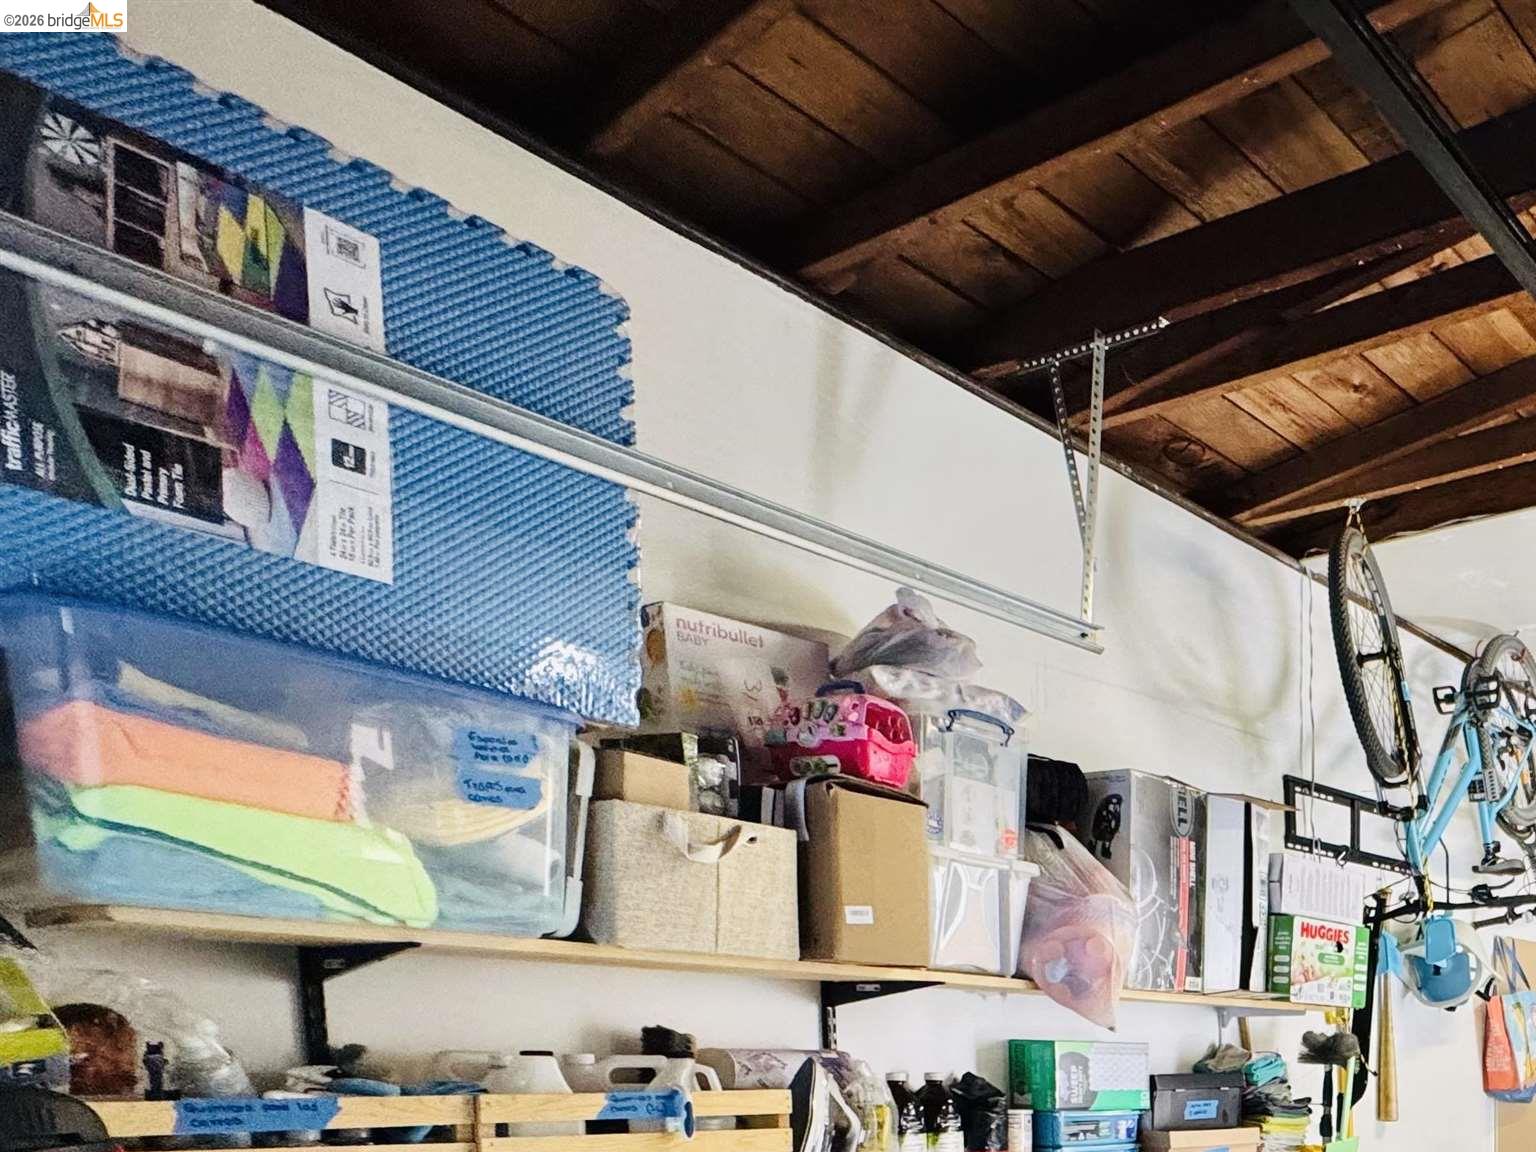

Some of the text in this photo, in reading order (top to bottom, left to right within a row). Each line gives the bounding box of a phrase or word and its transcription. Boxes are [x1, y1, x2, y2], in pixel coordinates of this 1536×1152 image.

[675, 617, 764, 649] nutribullet
[676, 631, 708, 646] BABY
[1300, 921, 1349, 944] HUGGIES
